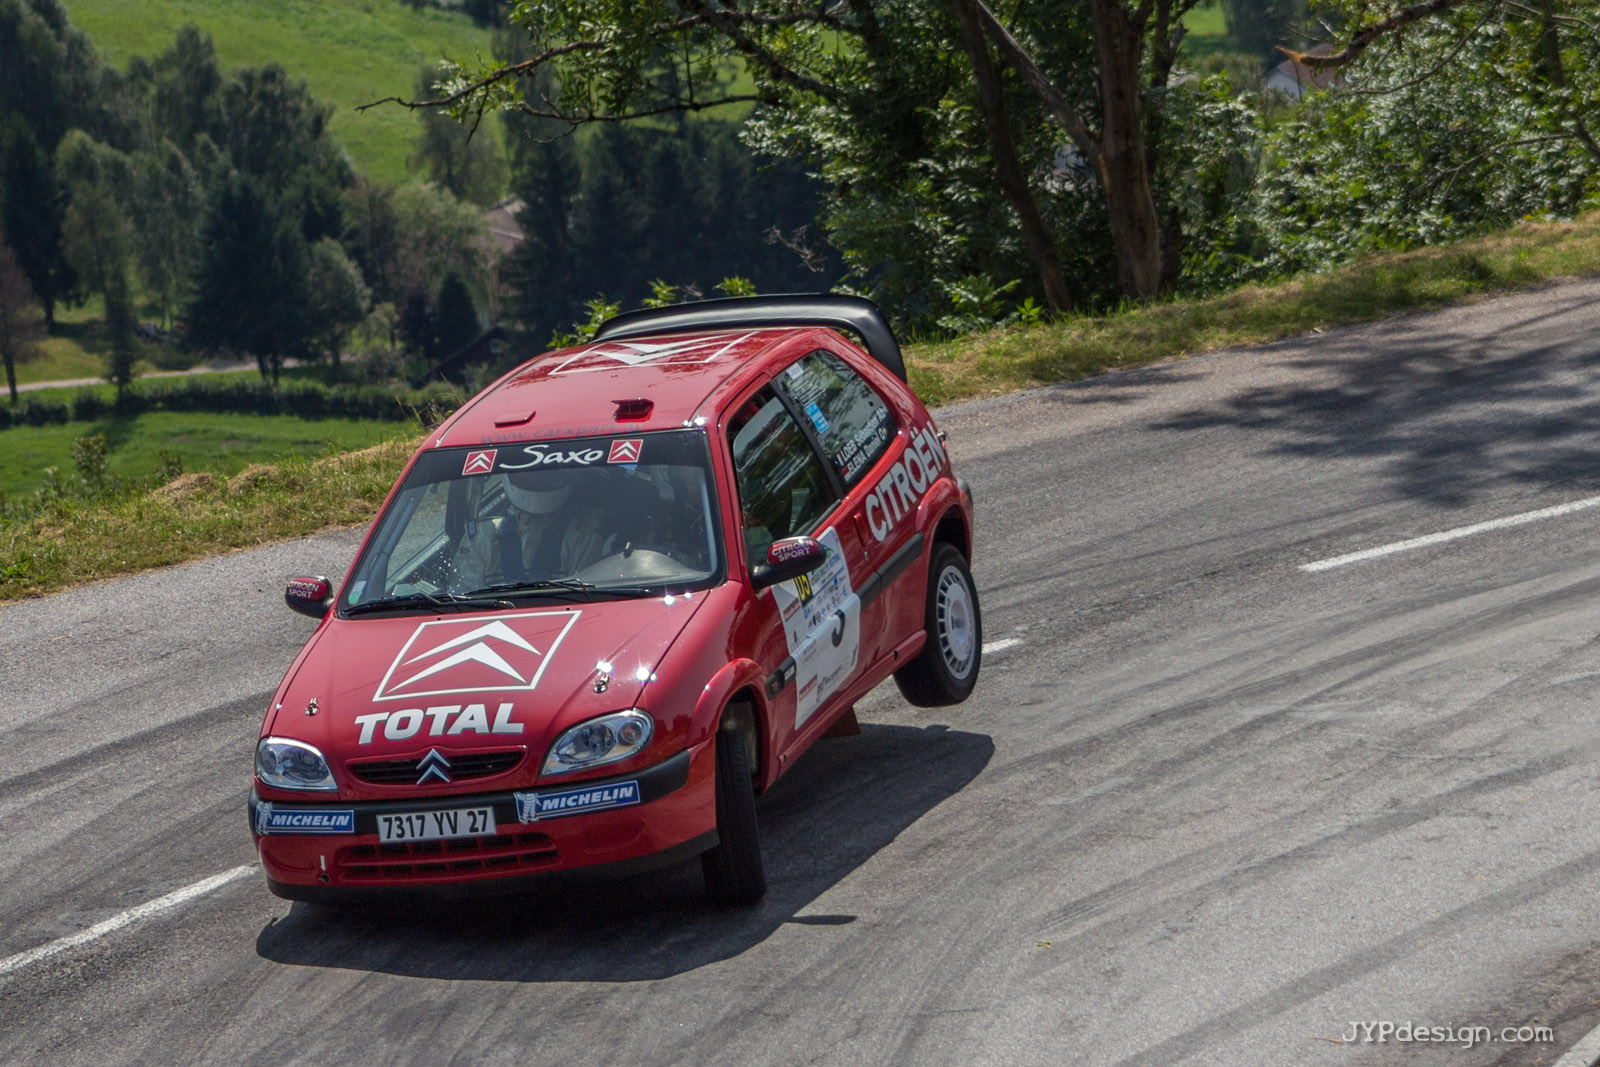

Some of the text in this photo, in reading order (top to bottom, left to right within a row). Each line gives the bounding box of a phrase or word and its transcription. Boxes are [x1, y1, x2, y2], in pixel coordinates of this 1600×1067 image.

[499, 444, 603, 469] Saxo
[841, 443, 857, 464] LOEB
[847, 452, 869, 475] ELENA
[865, 421, 947, 542] CITROËN
[778, 549, 811, 562] SPORT
[288, 588, 313, 598] SPORT
[354, 702, 525, 745] TOTAL
[541, 785, 634, 811] MICHELIN
[271, 814, 350, 828] MICHELIN
[382, 810, 489, 841] 7317 YV 27
